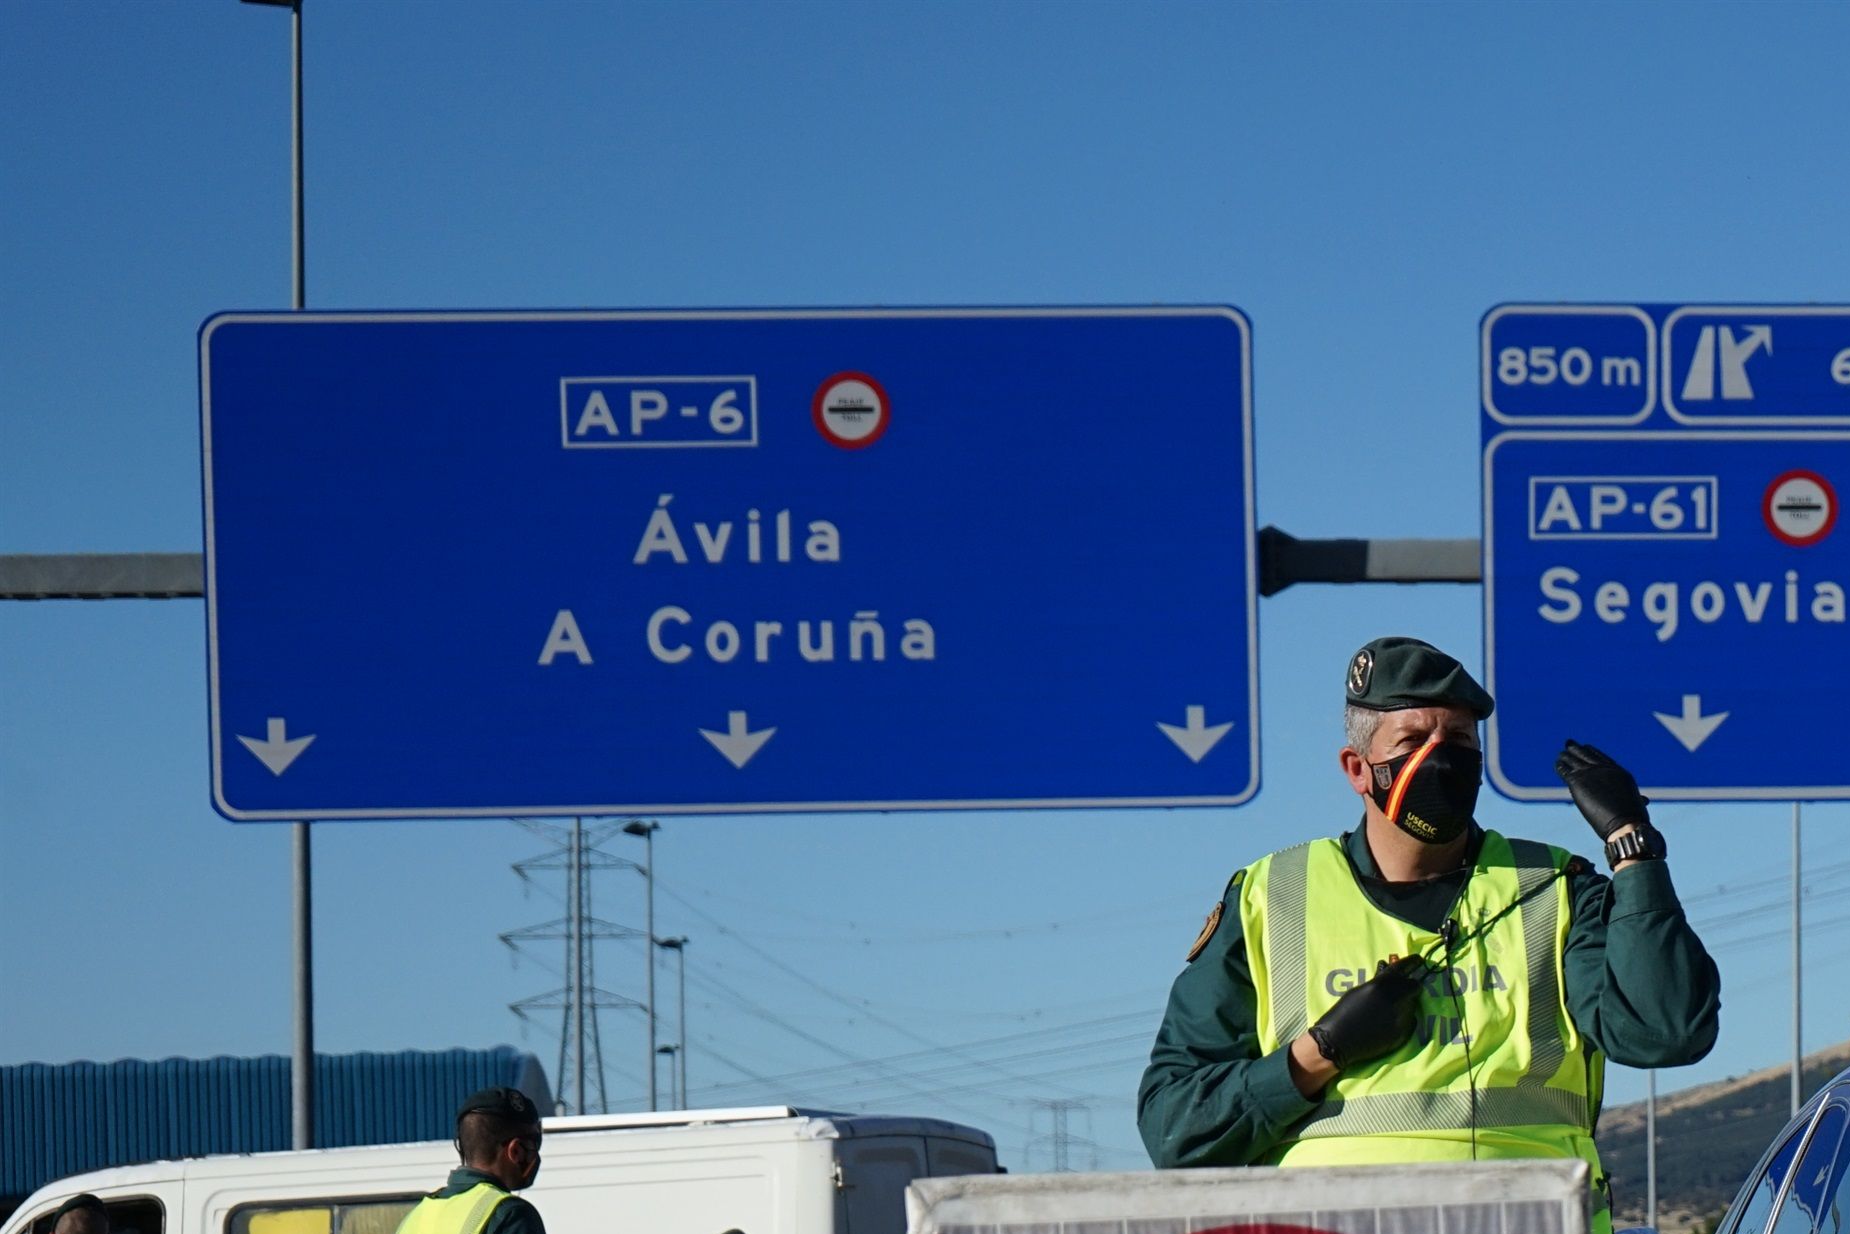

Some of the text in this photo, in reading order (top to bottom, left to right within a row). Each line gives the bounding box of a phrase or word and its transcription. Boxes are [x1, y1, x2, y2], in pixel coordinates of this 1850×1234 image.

[1498, 348, 1640, 386] 850 m
[576, 391, 745, 436] AP-6
[633, 494, 841, 564] Ávila
[1540, 487, 1706, 530] AP-61
[1539, 567, 1846, 643] Segovia
[538, 606, 935, 666] A Coruña
[1407, 811, 1438, 835] USECIC
